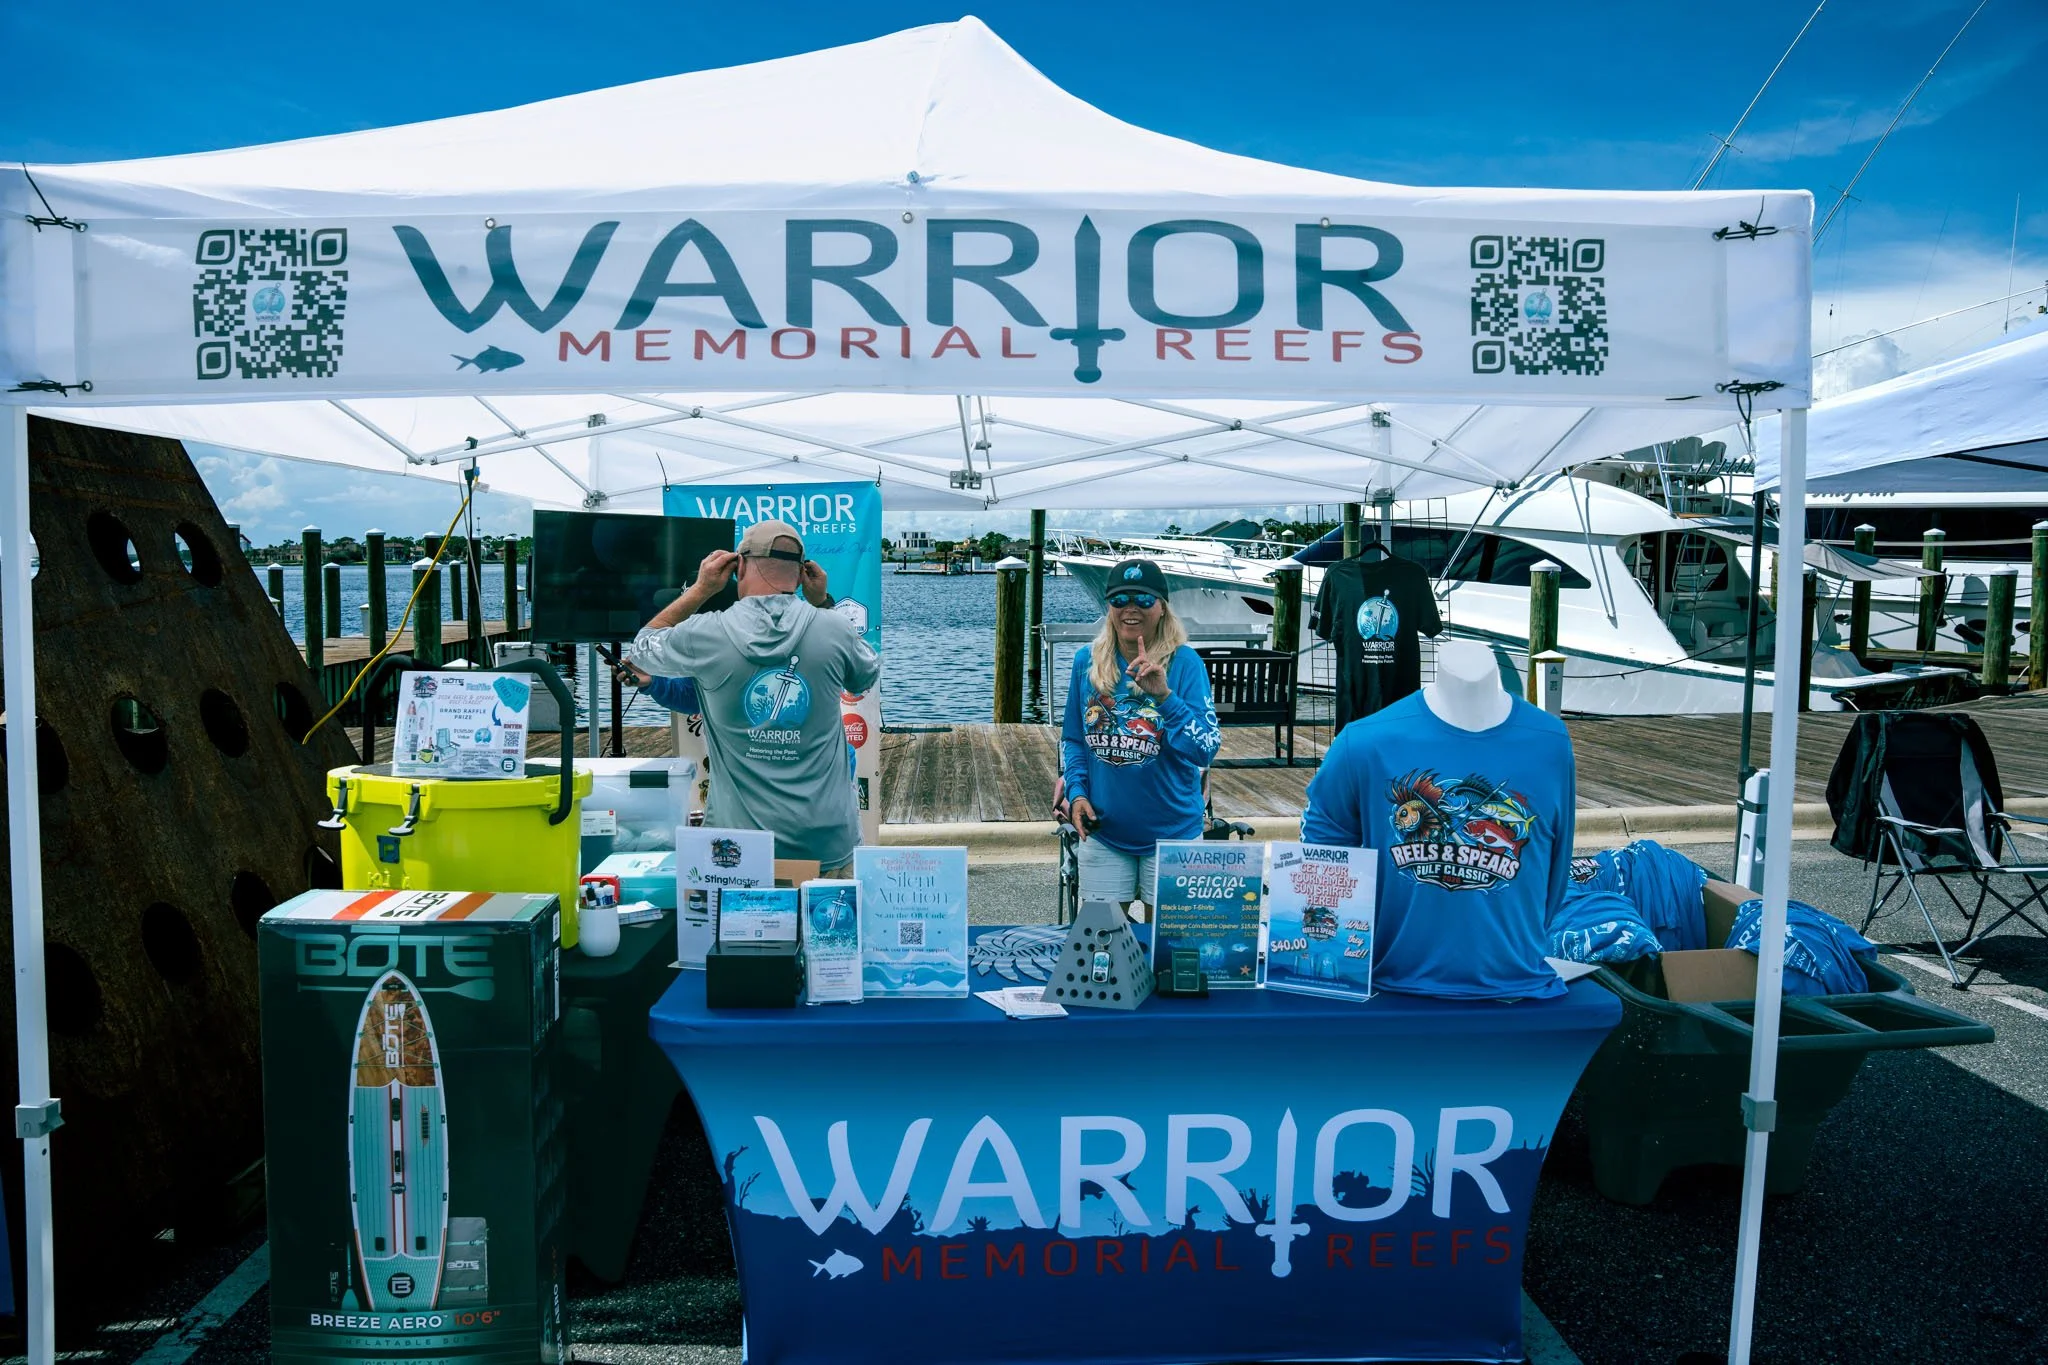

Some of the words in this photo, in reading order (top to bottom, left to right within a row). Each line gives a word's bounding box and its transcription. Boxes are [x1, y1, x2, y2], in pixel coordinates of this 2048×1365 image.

[391, 215, 1414, 334] WARRIOR
[557, 324, 1038, 363] MEMORIAL
[1155, 327, 1424, 365] REEFS
[813, 523, 857, 534] REEFS
[1362, 641, 1395, 649] WARRIOR
[747, 729, 801, 741] WARRIOR
[750, 746, 773, 755] Honoring
[1110, 737, 1119, 748] &
[1120, 736, 1160, 755] SPEARS
[1111, 749, 1142, 760] CLASSIC
[1178, 852, 1246, 865] WARRIOR
[1302, 848, 1349, 860] WARRIOR
[1391, 844, 1439, 866] REELS
[1441, 845, 1455, 862] &
[1457, 845, 1520, 880] SPEARS
[1301, 864, 1319, 874] GET
[1322, 864, 1349, 877] YOUR
[1417, 864, 1441, 876] GULF
[1443, 865, 1489, 883] CLASSIC
[704, 875, 760, 887] StingMaster
[887, 872, 934, 888] Silent
[1176, 875, 1246, 888] OFFICIAL
[1290, 872, 1358, 889] TOURNAMENT
[880, 887, 948, 905] Auction
[1187, 887, 1235, 899] SWAG
[1294, 884, 1315, 895] SUN
[1316, 886, 1352, 899] SHIRTS
[1178, 904, 1192, 912] Logo
[1307, 895, 1339, 908] HERE!!
[1218, 923, 1239, 931] Opener
[1344, 920, 1369, 931] While
[1270, 938, 1307, 953] $40.00
[1347, 934, 1364, 947] they
[753, 1106, 1515, 1240] WARRIOR
[881, 1236, 1239, 1281] MEMORIAL
[1326, 1225, 1513, 1269] REEFS
[310, 1313, 381, 1329] BREEZE
[339, 1338, 432, 1346] INFLATABLE
